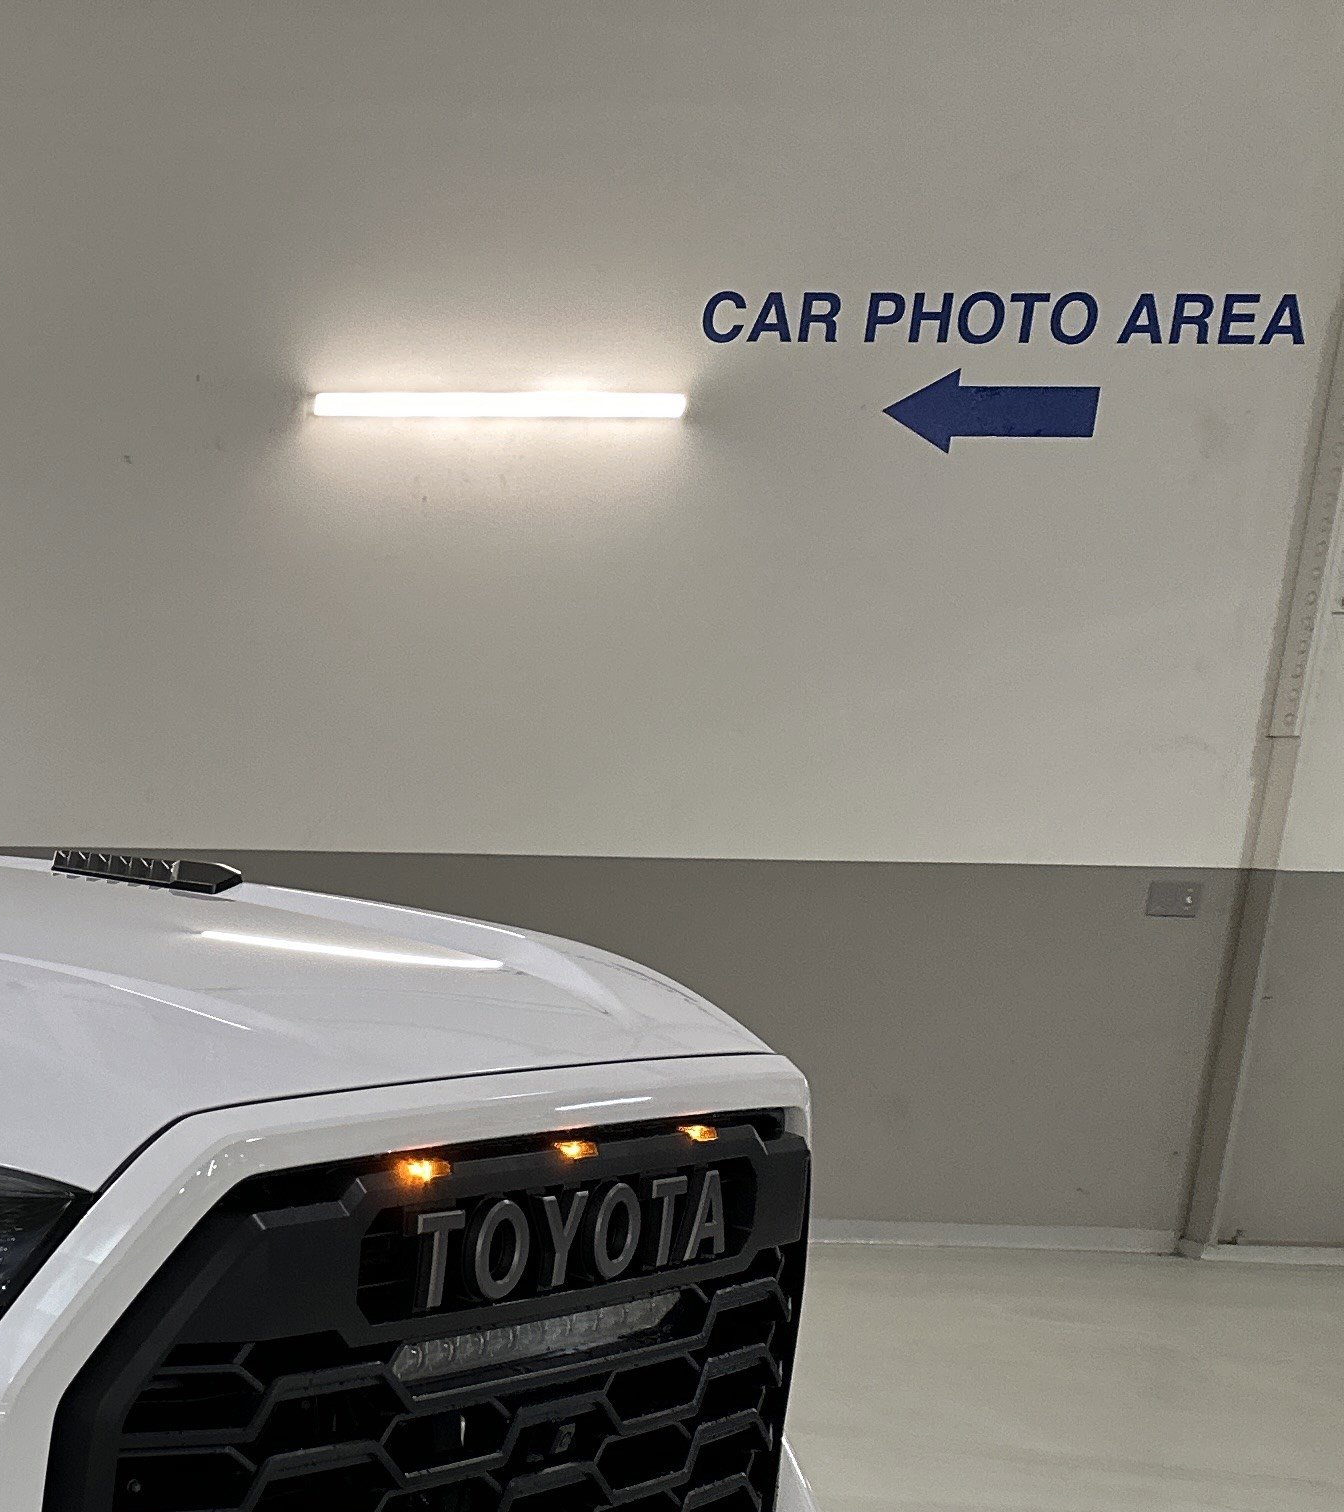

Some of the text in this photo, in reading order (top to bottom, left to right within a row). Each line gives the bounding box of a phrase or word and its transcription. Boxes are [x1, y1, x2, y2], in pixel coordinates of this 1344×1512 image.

[702, 291, 1305, 345] CAR PHOTO AREA
[417, 1169, 726, 1309] TOYOTA
